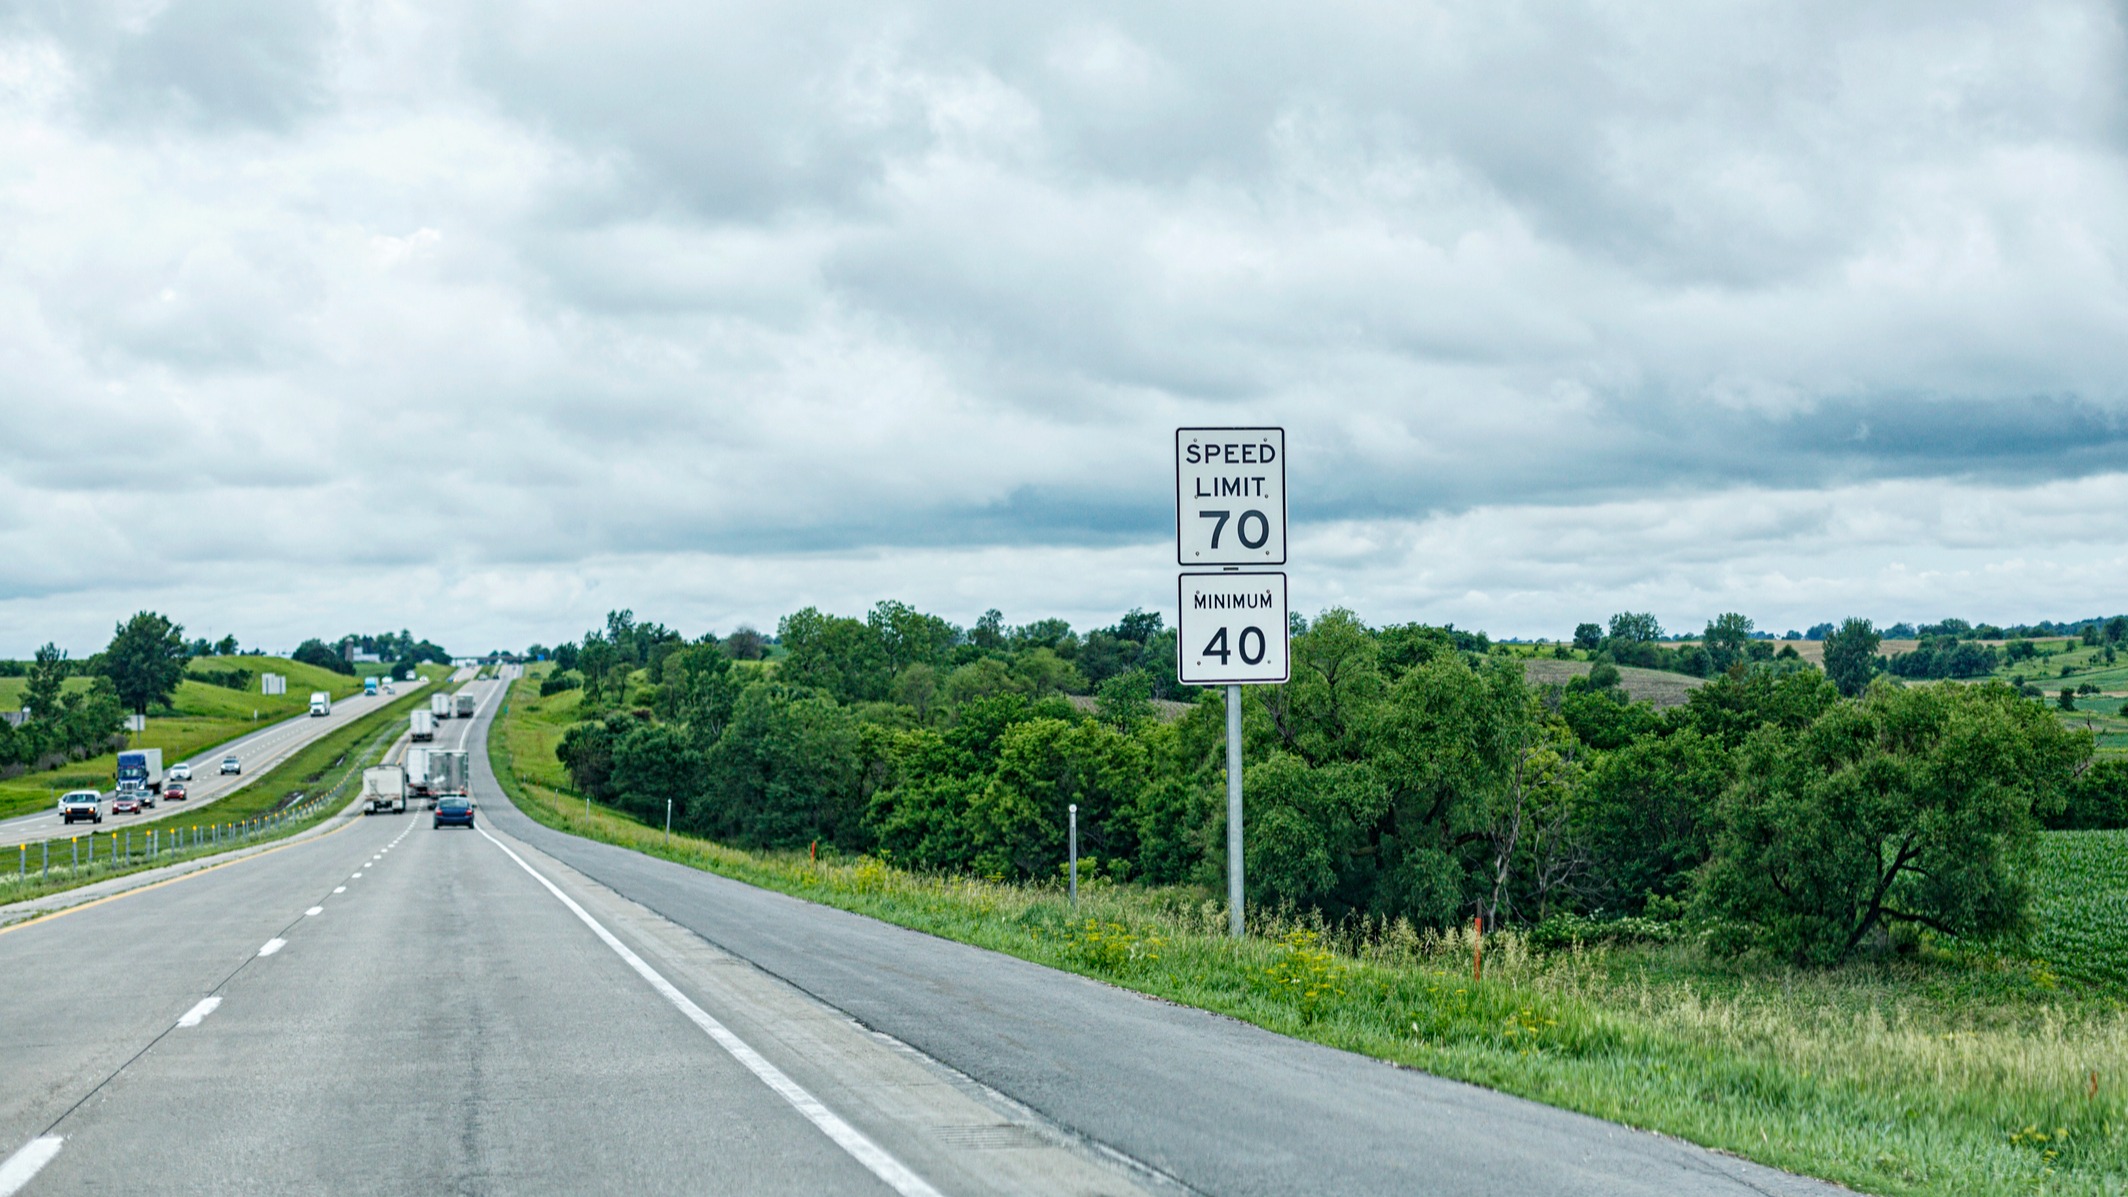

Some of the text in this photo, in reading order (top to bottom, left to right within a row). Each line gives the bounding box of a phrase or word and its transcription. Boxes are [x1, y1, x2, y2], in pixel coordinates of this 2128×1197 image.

[1186, 443, 1276, 464] SPEED
[1196, 476, 1266, 497] LIMIT
[1199, 509, 1270, 549] 70
[1194, 593, 1272, 609] MINIMUM
[1202, 626, 1266, 666] 40
